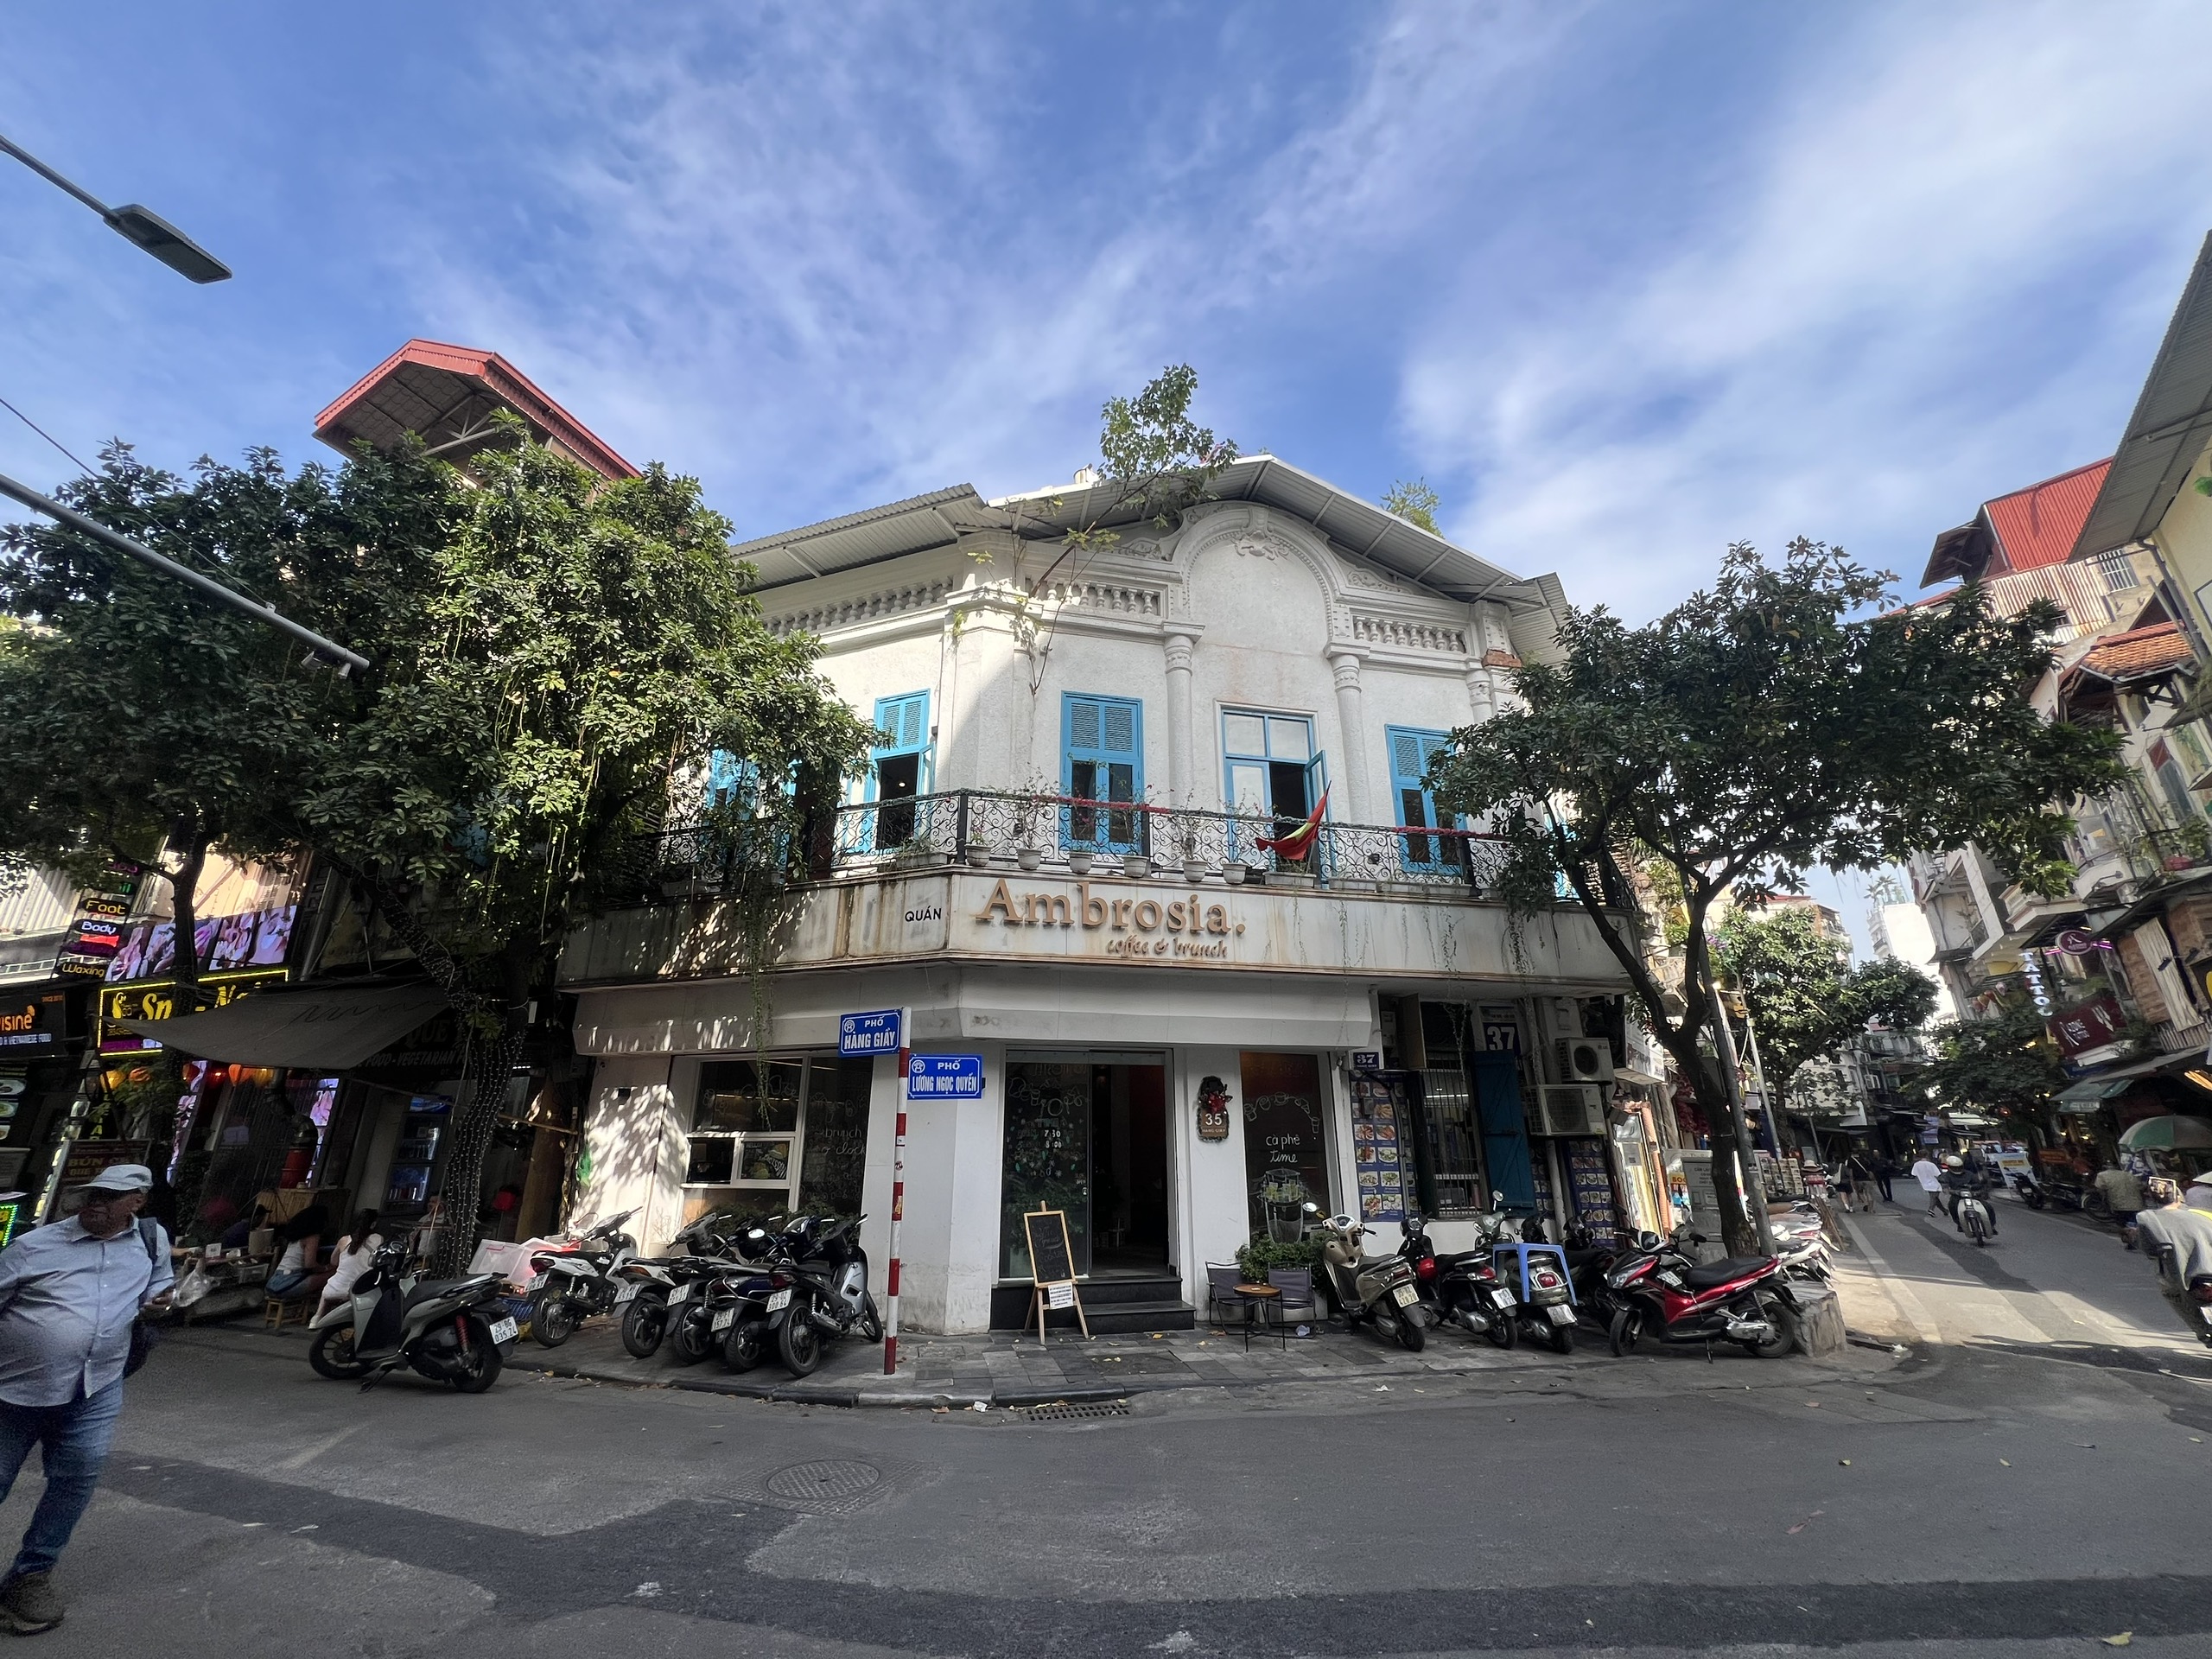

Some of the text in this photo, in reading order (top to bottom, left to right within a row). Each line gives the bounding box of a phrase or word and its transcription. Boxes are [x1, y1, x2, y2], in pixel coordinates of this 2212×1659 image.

[86, 900, 126, 915] Foot
[905, 905, 942, 922] QUÁN
[976, 878, 1245, 933] Ambrosia.
[81, 921, 116, 935] Body
[1107, 934, 1148, 958] coffee
[1173, 937, 1228, 958] brunch
[61, 963, 105, 977] Waxing
[0, 1014, 32, 1032] isine
[865, 1016, 885, 1028] PHỐ
[844, 1031, 871, 1050] HÀNG
[1487, 1026, 1516, 1051] 37
[938, 1059, 961, 1071] PHỐ
[1357, 1054, 1376, 1064] 37
[912, 1072, 977, 1095] LƯƠNG NGỌC QUYẾN
[1205, 1113, 1223, 1126] 35
[1265, 1133, 1300, 1150] cà phê
[1270, 1150, 1299, 1164] time
